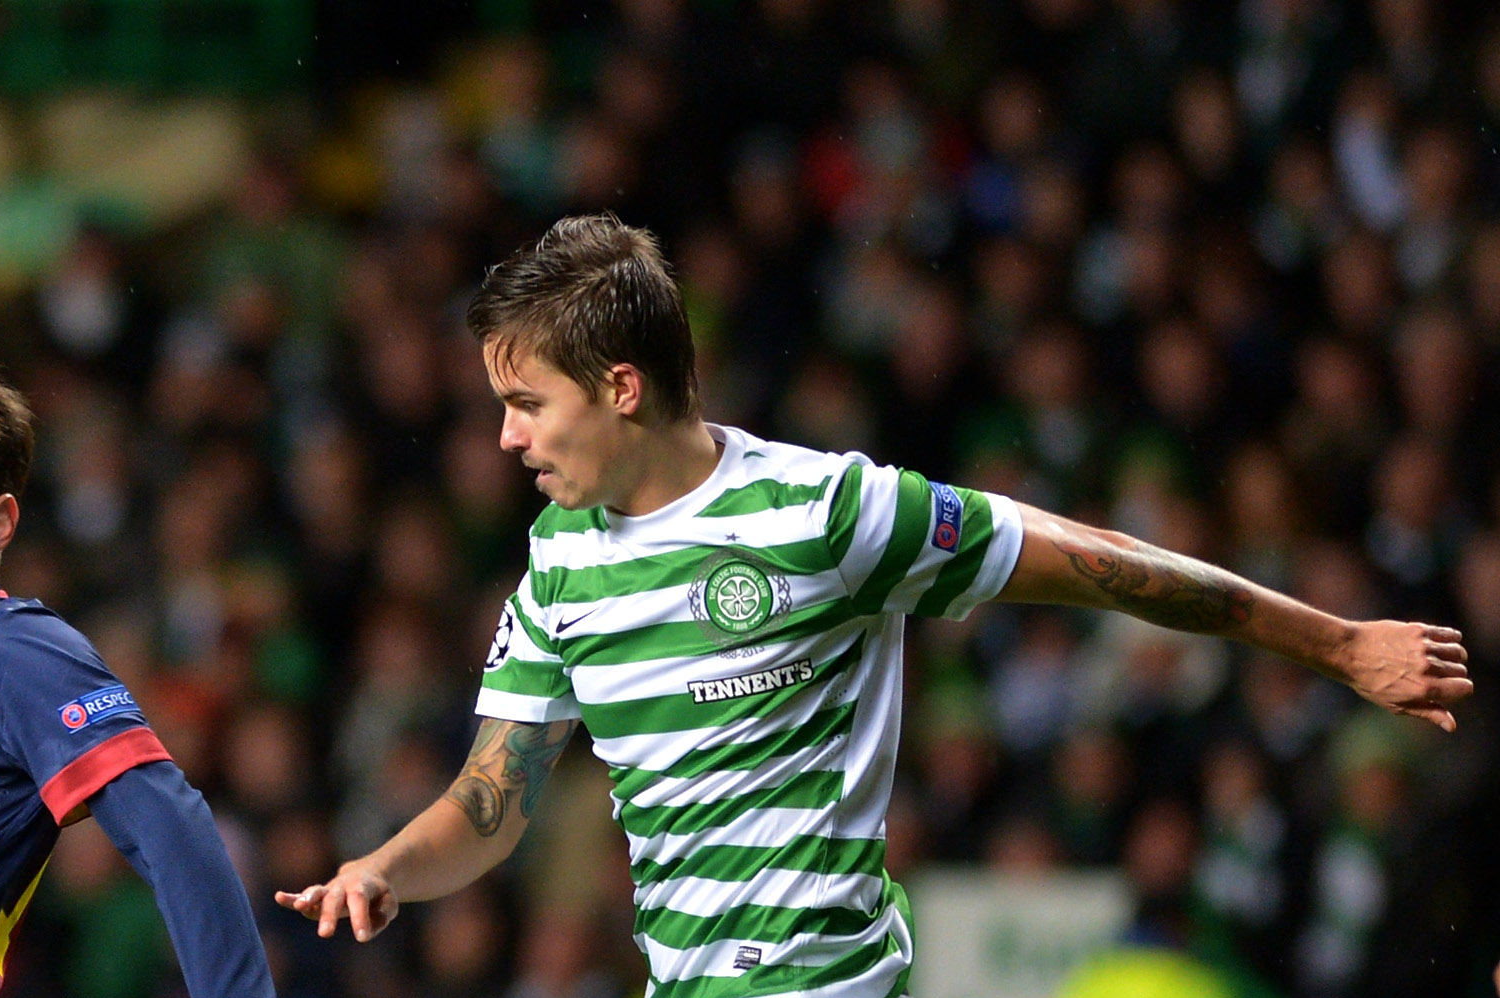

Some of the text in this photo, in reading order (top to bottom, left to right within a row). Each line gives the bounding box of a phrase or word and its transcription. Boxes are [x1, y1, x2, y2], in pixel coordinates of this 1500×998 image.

[712, 568, 730, 588] CELTIC
[730, 566, 760, 582] FOOTBALL
[757, 580, 769, 599] CLUB
[689, 660, 813, 703] TENNENT'S
